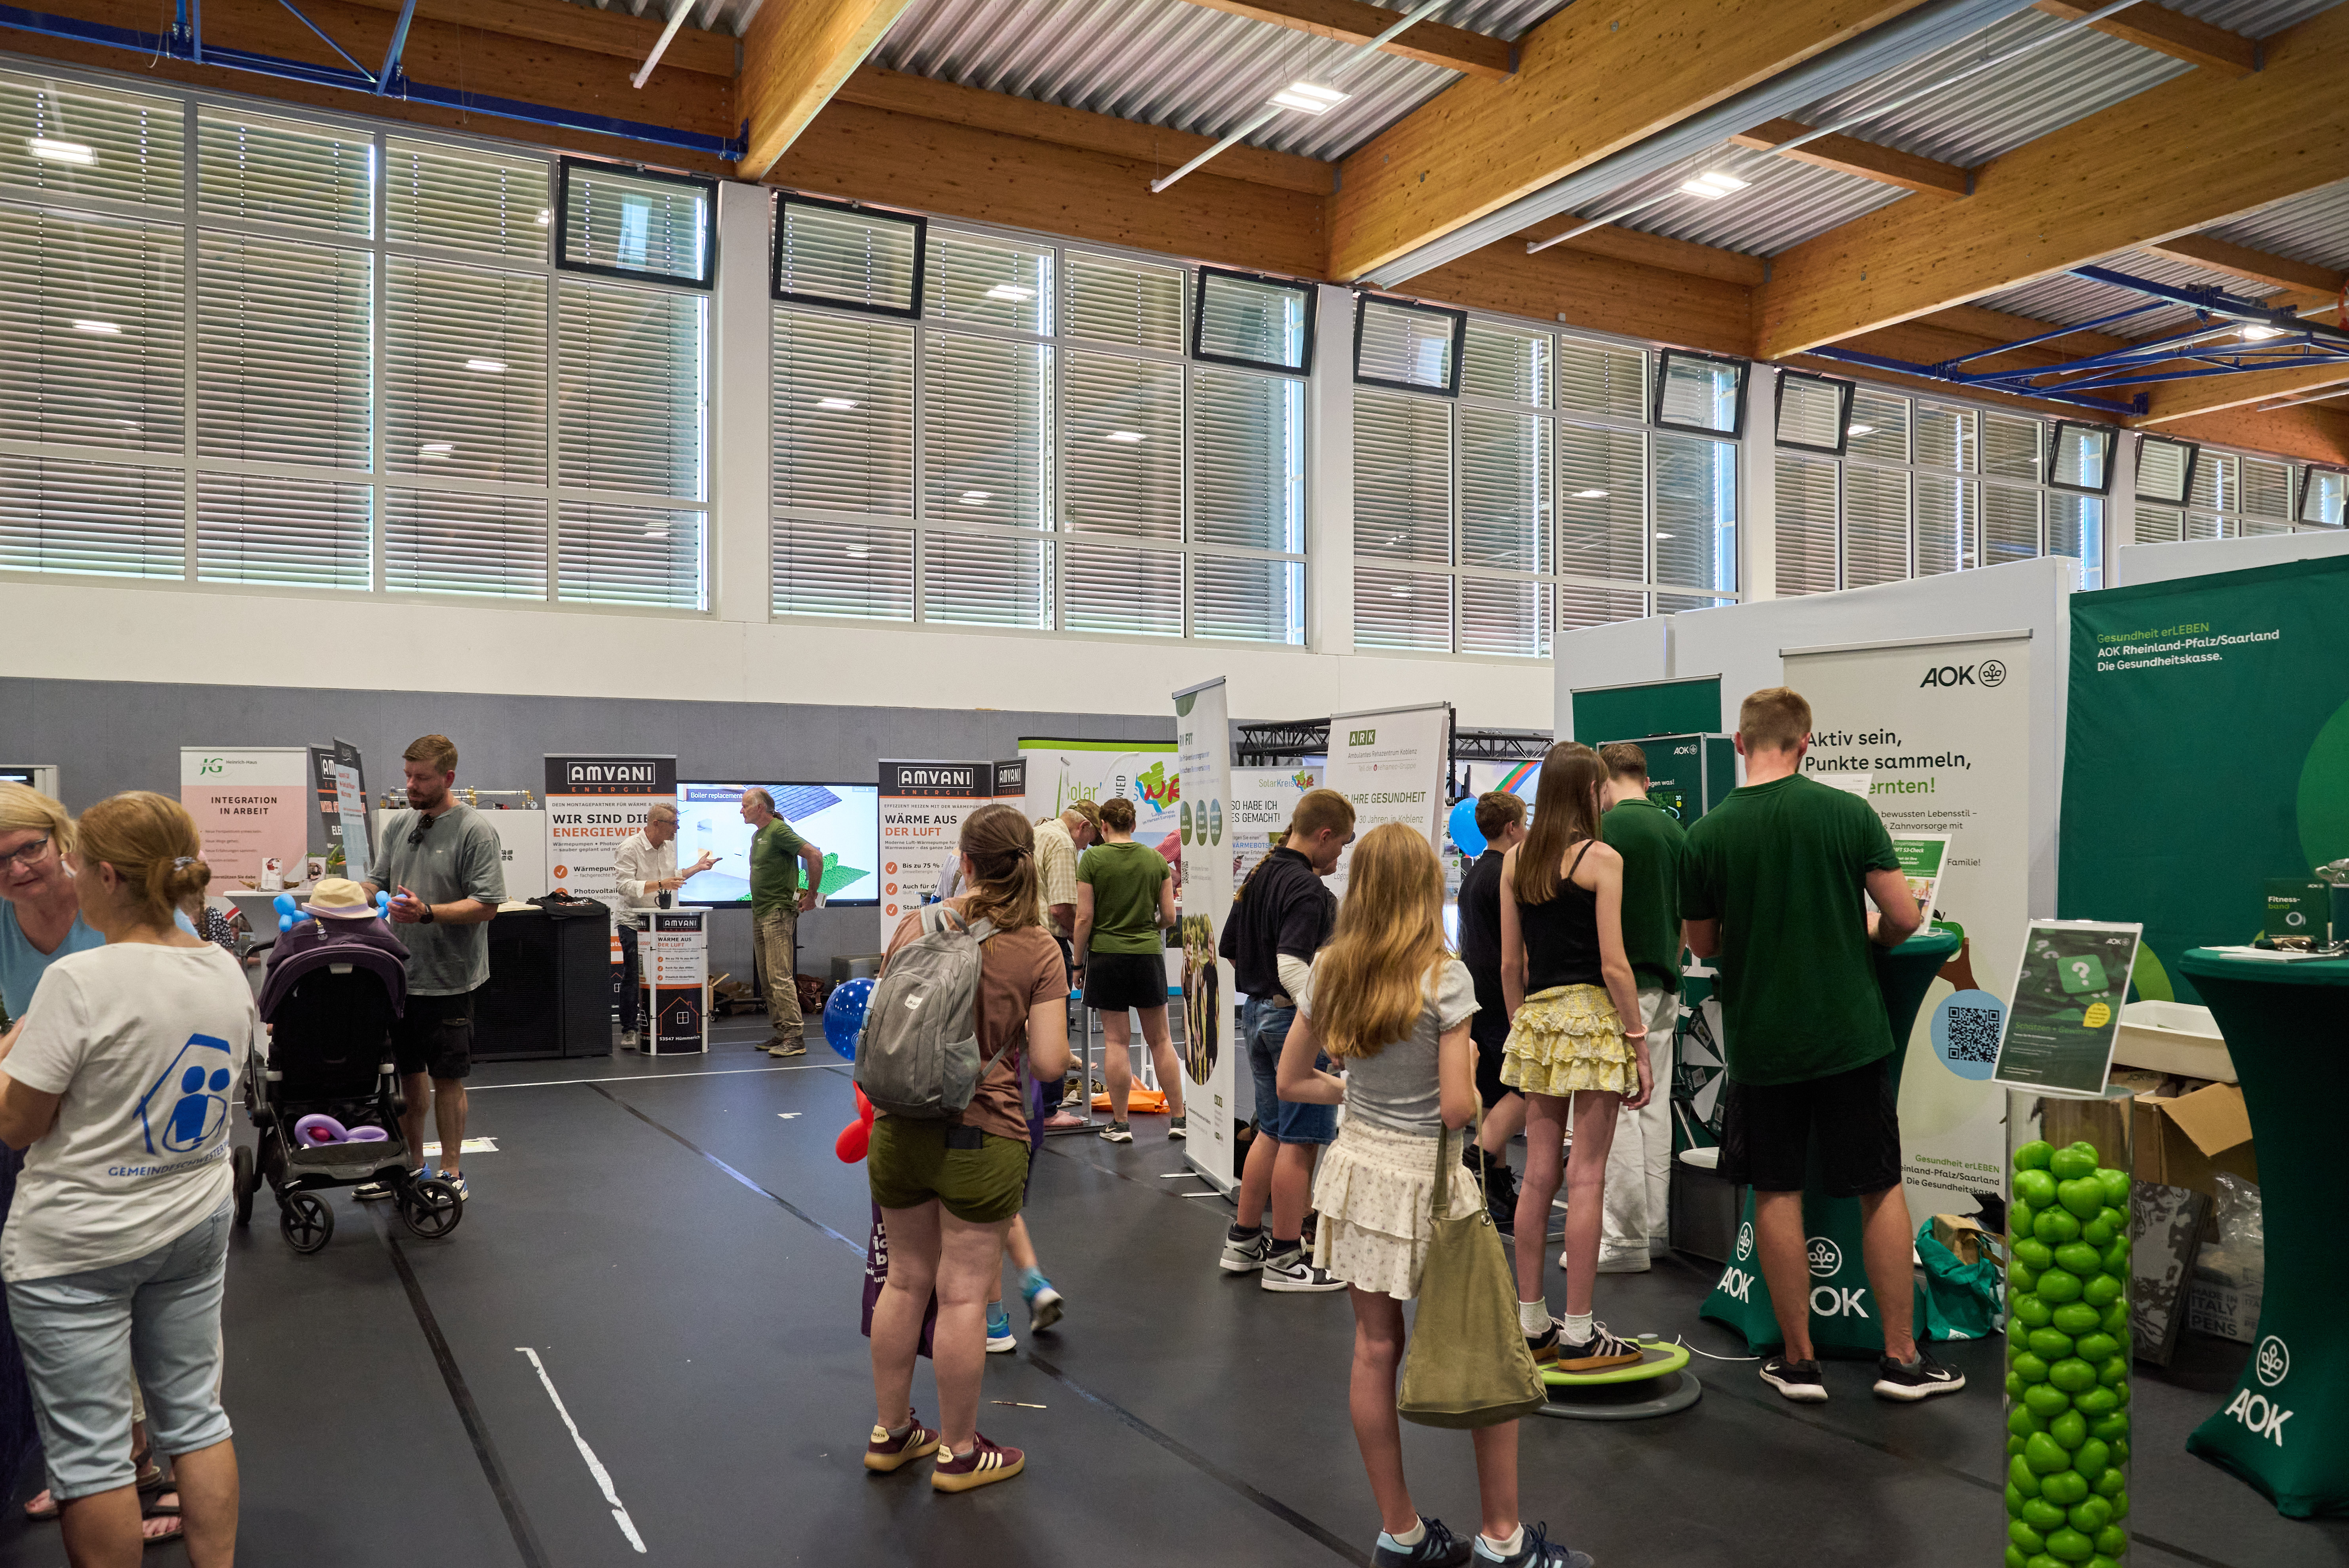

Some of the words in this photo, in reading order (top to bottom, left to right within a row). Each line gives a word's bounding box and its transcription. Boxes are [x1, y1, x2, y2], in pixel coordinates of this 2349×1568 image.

[2098, 629, 2159, 644] Gesundheit
[2161, 622, 2209, 637] erLEBEN
[2098, 646, 2121, 657] AOK
[2123, 629, 2279, 656] Rheinland-Pfalz/Saarland
[2098, 661, 2115, 671] Die
[2117, 652, 2223, 670] Gesundheitskasse.
[1919, 665, 1975, 688] AOK
[1350, 731, 1374, 744] ARK
[1808, 730, 1853, 747] Aktiv
[1858, 728, 1902, 747] sein,
[1674, 747, 1690, 755] AOK
[1805, 755, 1869, 772] Punkte
[1874, 751, 1971, 770] sammeln,
[571, 766, 651, 781] AMVANI
[901, 770, 970, 785] AMVANI
[999, 768, 1021, 783] AMVANI
[1259, 779, 1294, 787] SolarKreis
[1869, 777, 1935, 794] ernten!
[1351, 793, 1369, 804] IHRE
[1371, 791, 1426, 804] GESUNDHEIT
[1232, 801, 1240, 810] SO
[1243, 801, 1263, 810] HABE
[1265, 801, 1277, 810] ICH
[1928, 809, 1971, 817] Lebensstil
[553, 814, 582, 824] WIR
[587, 814, 622, 824] SIND
[885, 813, 929, 824] WÄRME
[933, 815, 957, 824] AUS
[1242, 813, 1280, 823] GEMACHT!
[1359, 815, 1366, 824] 30
[1399, 814, 1423, 823] Koblenz
[885, 828, 909, 836] DER
[913, 828, 942, 836] LUFT
[1889, 822, 1947, 831] Zahnvorsorge
[1948, 821, 1963, 830] mit
[1947, 857, 1980, 867] Familie!
[1915, 1154, 1963, 1167] Gesundheit
[1965, 1161, 2000, 1173] erLEBEN
[1900, 1165, 2000, 1186] einland-Pfalz/Saarland
[1906, 1177, 1919, 1186] Die
[1716, 1266, 1755, 1304] AOK
[1810, 1285, 1869, 1318] OK
[2192, 1295, 2237, 1316] ITALY
[2192, 1315, 2237, 1336] PENS
[2224, 1388, 2294, 1448] AOK
